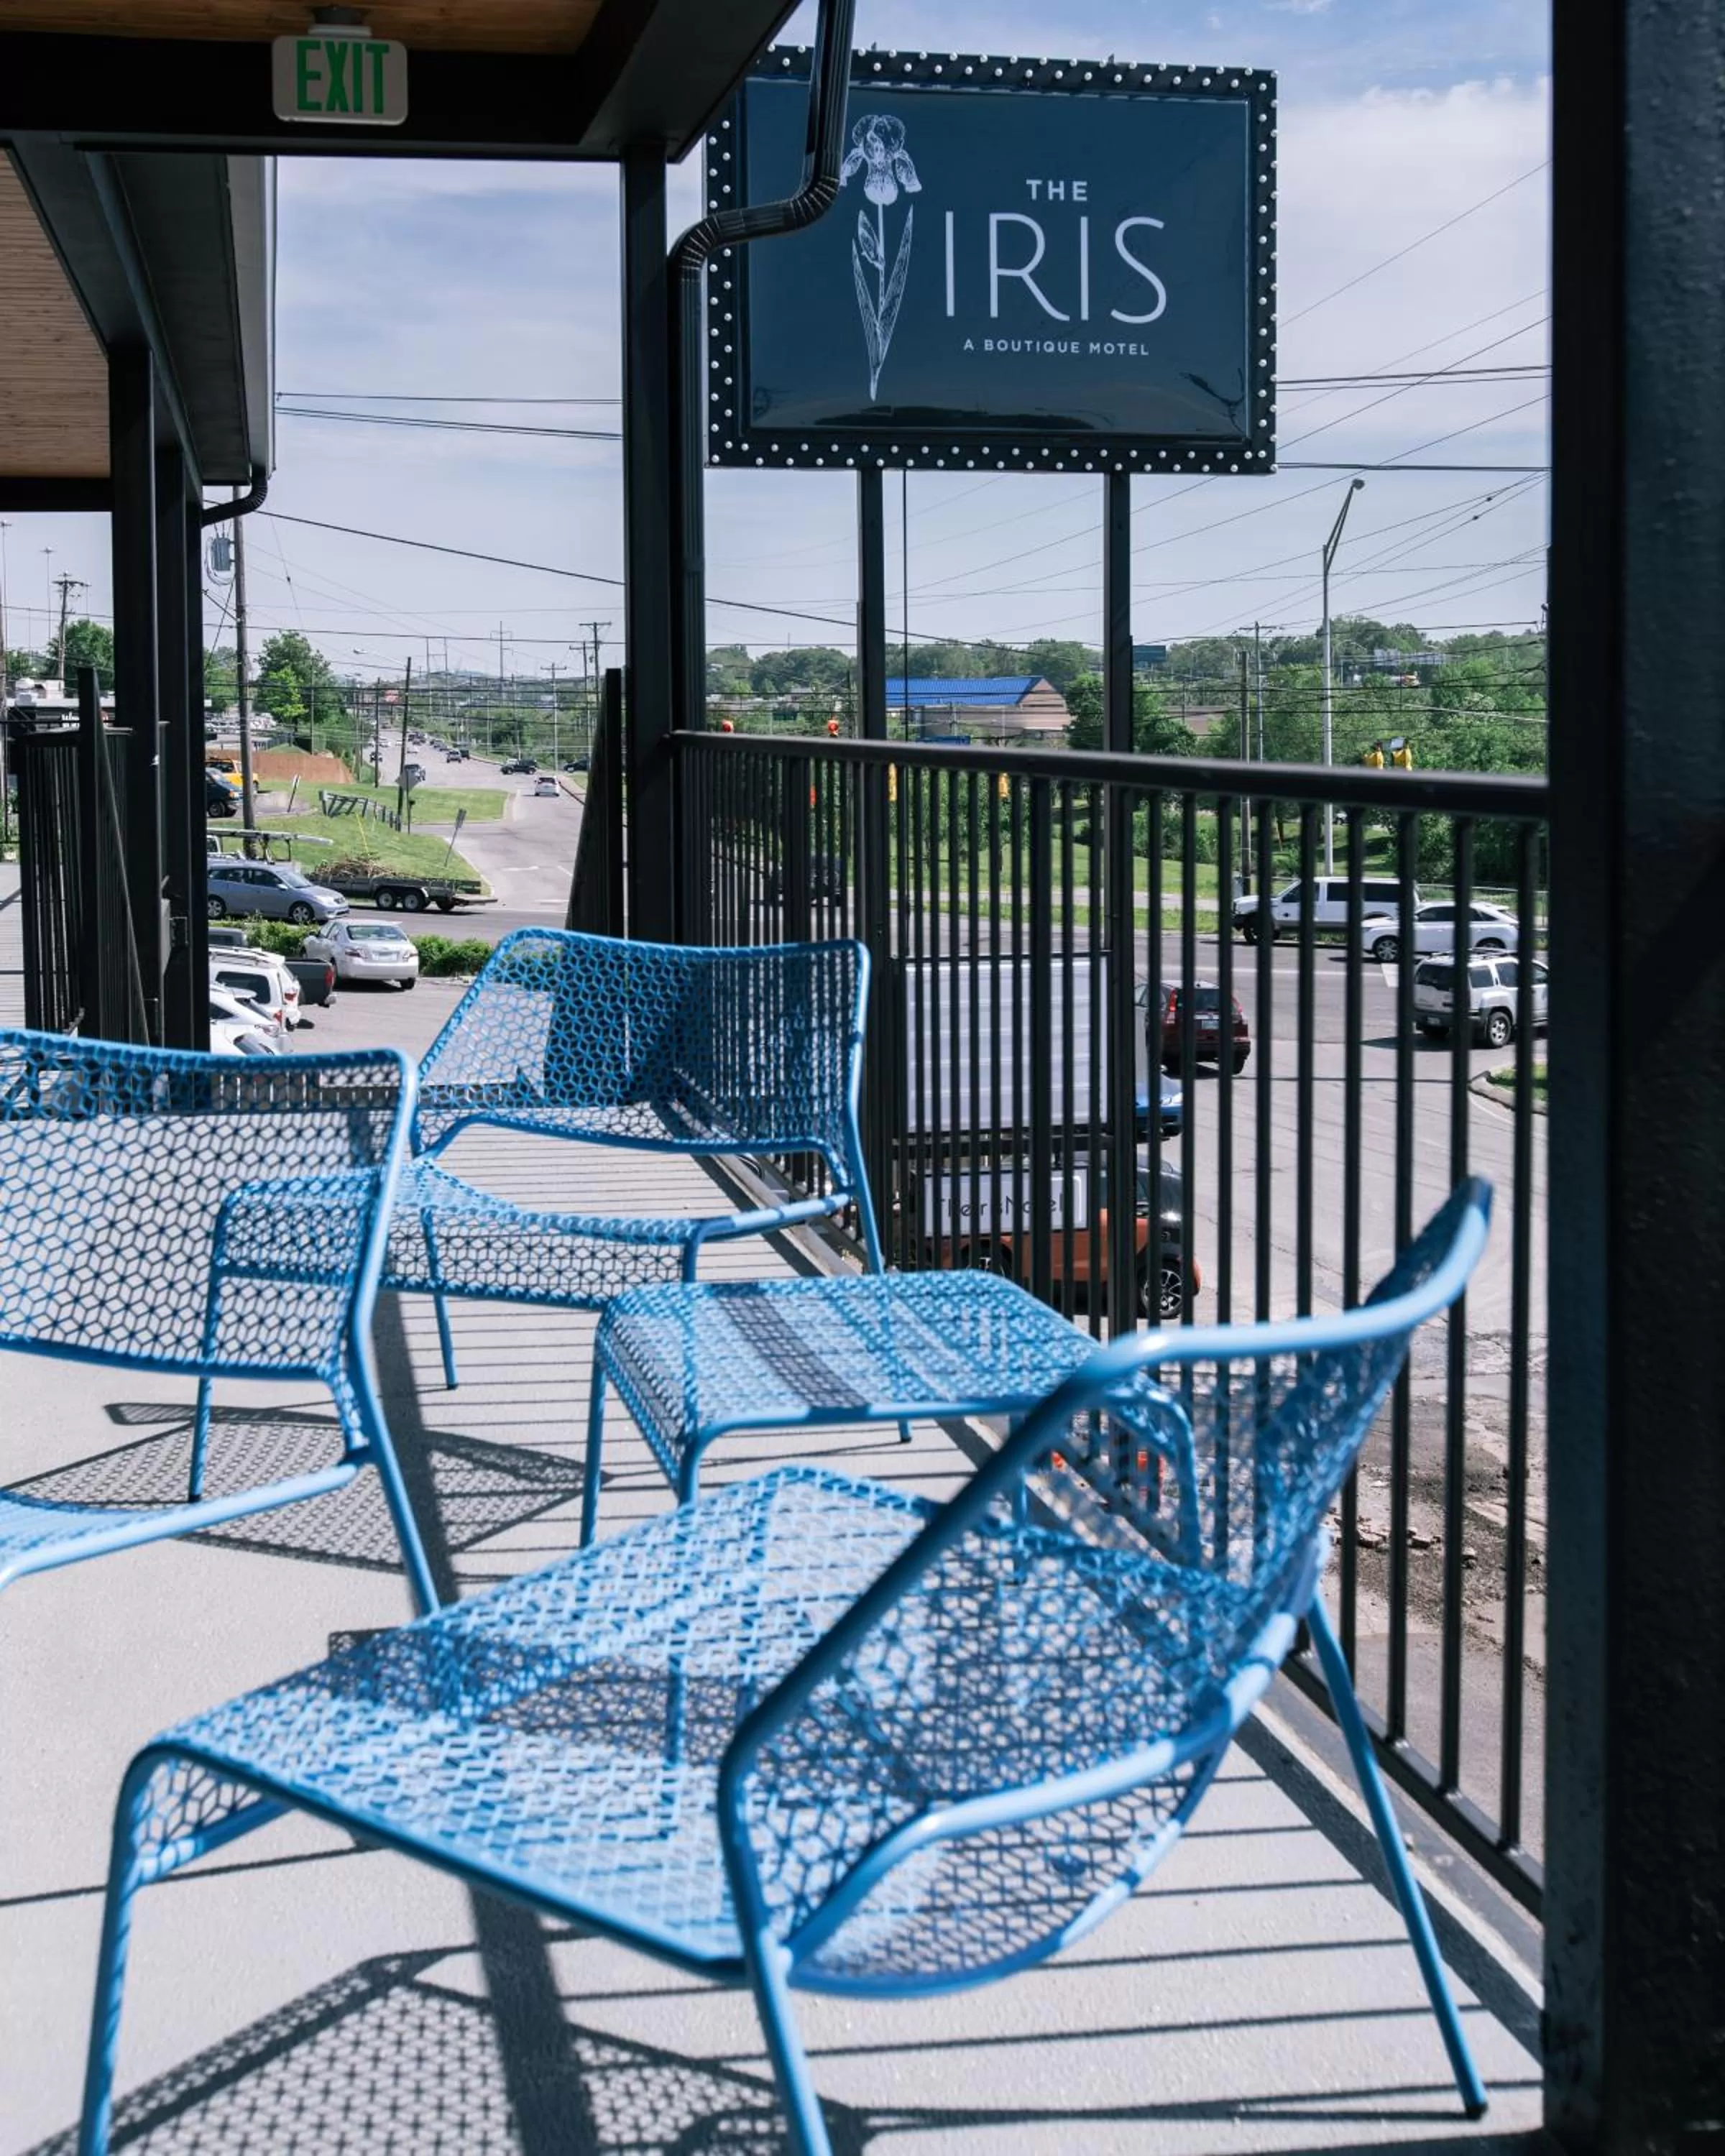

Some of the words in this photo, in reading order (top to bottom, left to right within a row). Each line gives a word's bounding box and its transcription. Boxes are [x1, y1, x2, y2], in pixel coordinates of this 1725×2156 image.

[296, 40, 390, 115] EXIT
[1026, 179, 1087, 201] THE
[945, 211, 1167, 323] IRIS
[962, 338, 975, 351] A
[984, 339, 1080, 354] BOUTIQUE
[1089, 342, 1149, 356] MOTEL
